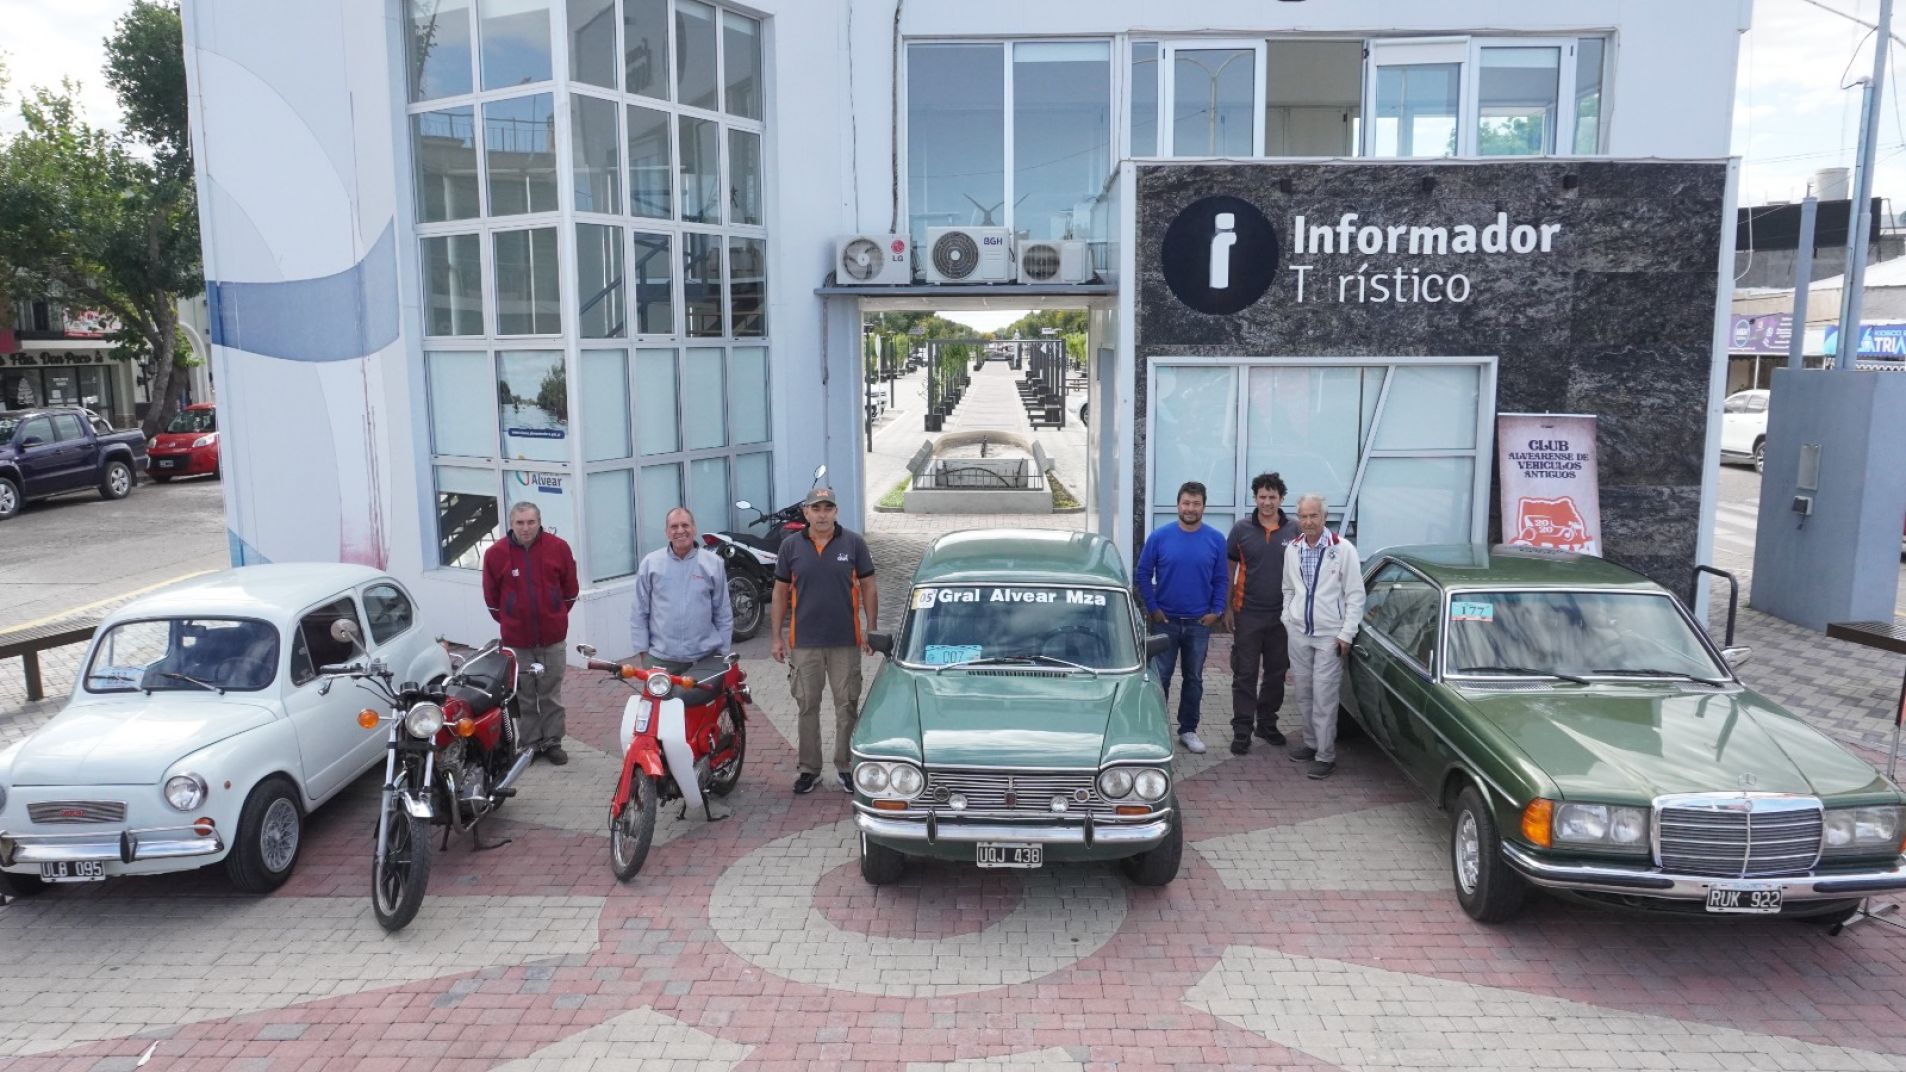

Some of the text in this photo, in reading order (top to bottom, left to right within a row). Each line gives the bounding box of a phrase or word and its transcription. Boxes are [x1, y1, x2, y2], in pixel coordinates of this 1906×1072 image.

[1294, 211, 1561, 255] Informador
[983, 236, 1003, 246] BGH
[1289, 263, 1470, 303] Trístico
[40, 351, 64, 365] Don
[64, 351, 92, 364] Paco
[1528, 439, 1569, 451] CLUB
[1508, 452, 1590, 461] ALVEARENSE DE
[1517, 461, 1582, 471] VEHICULOS
[531, 473, 562, 487] Alvear
[1523, 470, 1577, 479] ANTIGUOS
[1534, 519, 1549, 527] 20
[1539, 526, 1553, 534] 20
[919, 593, 933, 602] 05
[938, 588, 1106, 606] Gral Alvear Mza
[1461, 606, 1485, 617] 177
[979, 847, 1040, 863] UQJ 438
[75, 861, 102, 876] 095
[1710, 890, 1781, 907] RUK 922
